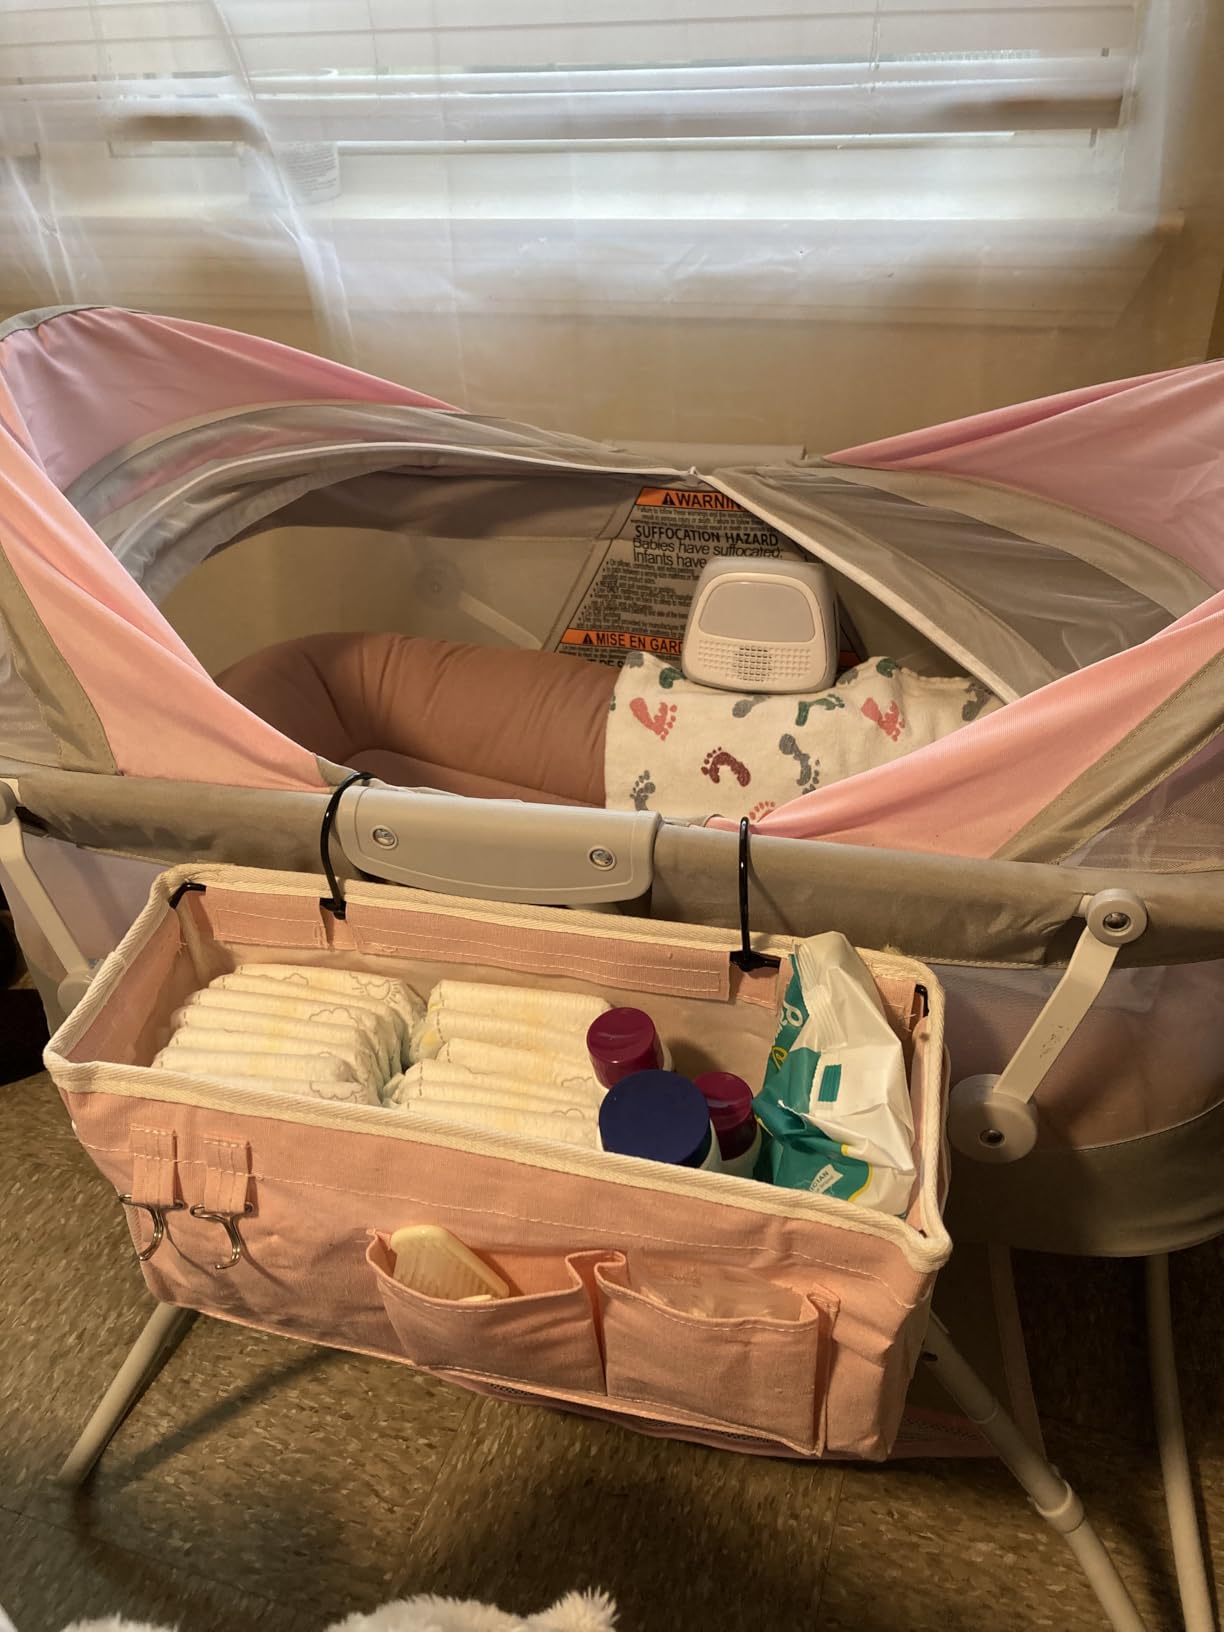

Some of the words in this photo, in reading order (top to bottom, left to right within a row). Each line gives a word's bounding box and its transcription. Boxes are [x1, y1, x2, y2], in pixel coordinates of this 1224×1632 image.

[635, 525, 720, 543] SUFFOCATION
[725, 532, 778, 547] HAZARD
[633, 537, 675, 553] Babies
[679, 541, 710, 555] have
[633, 548, 674, 566] Infants
[676, 553, 707, 569] have
[596, 632, 625, 647] MISE
[629, 636, 646, 649] EN
